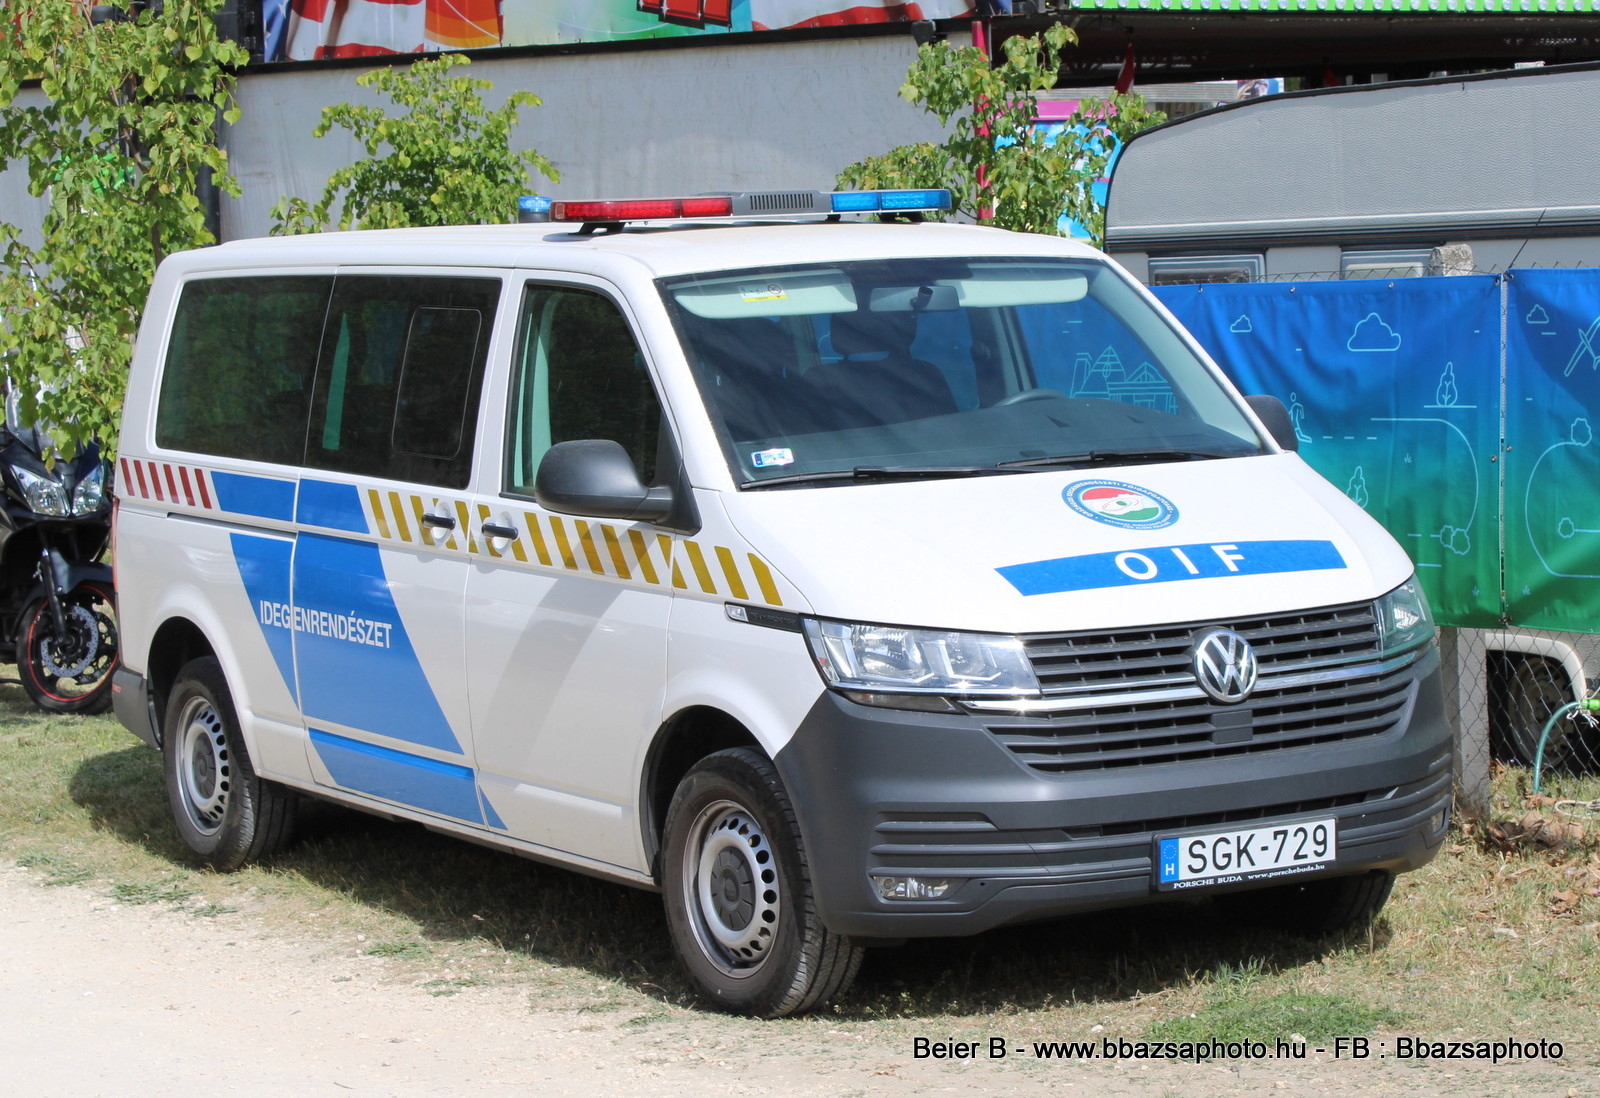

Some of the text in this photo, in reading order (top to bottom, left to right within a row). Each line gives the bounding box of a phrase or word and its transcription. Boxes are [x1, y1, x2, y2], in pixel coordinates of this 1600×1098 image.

[260, 600, 392, 648] IDEGENRENDÉSZET
[1187, 824, 1327, 874] SGK-729
[1165, 863, 1175, 876] H
[1173, 863, 1325, 889] PORSCHE BUDA www.porschebuda.hu
